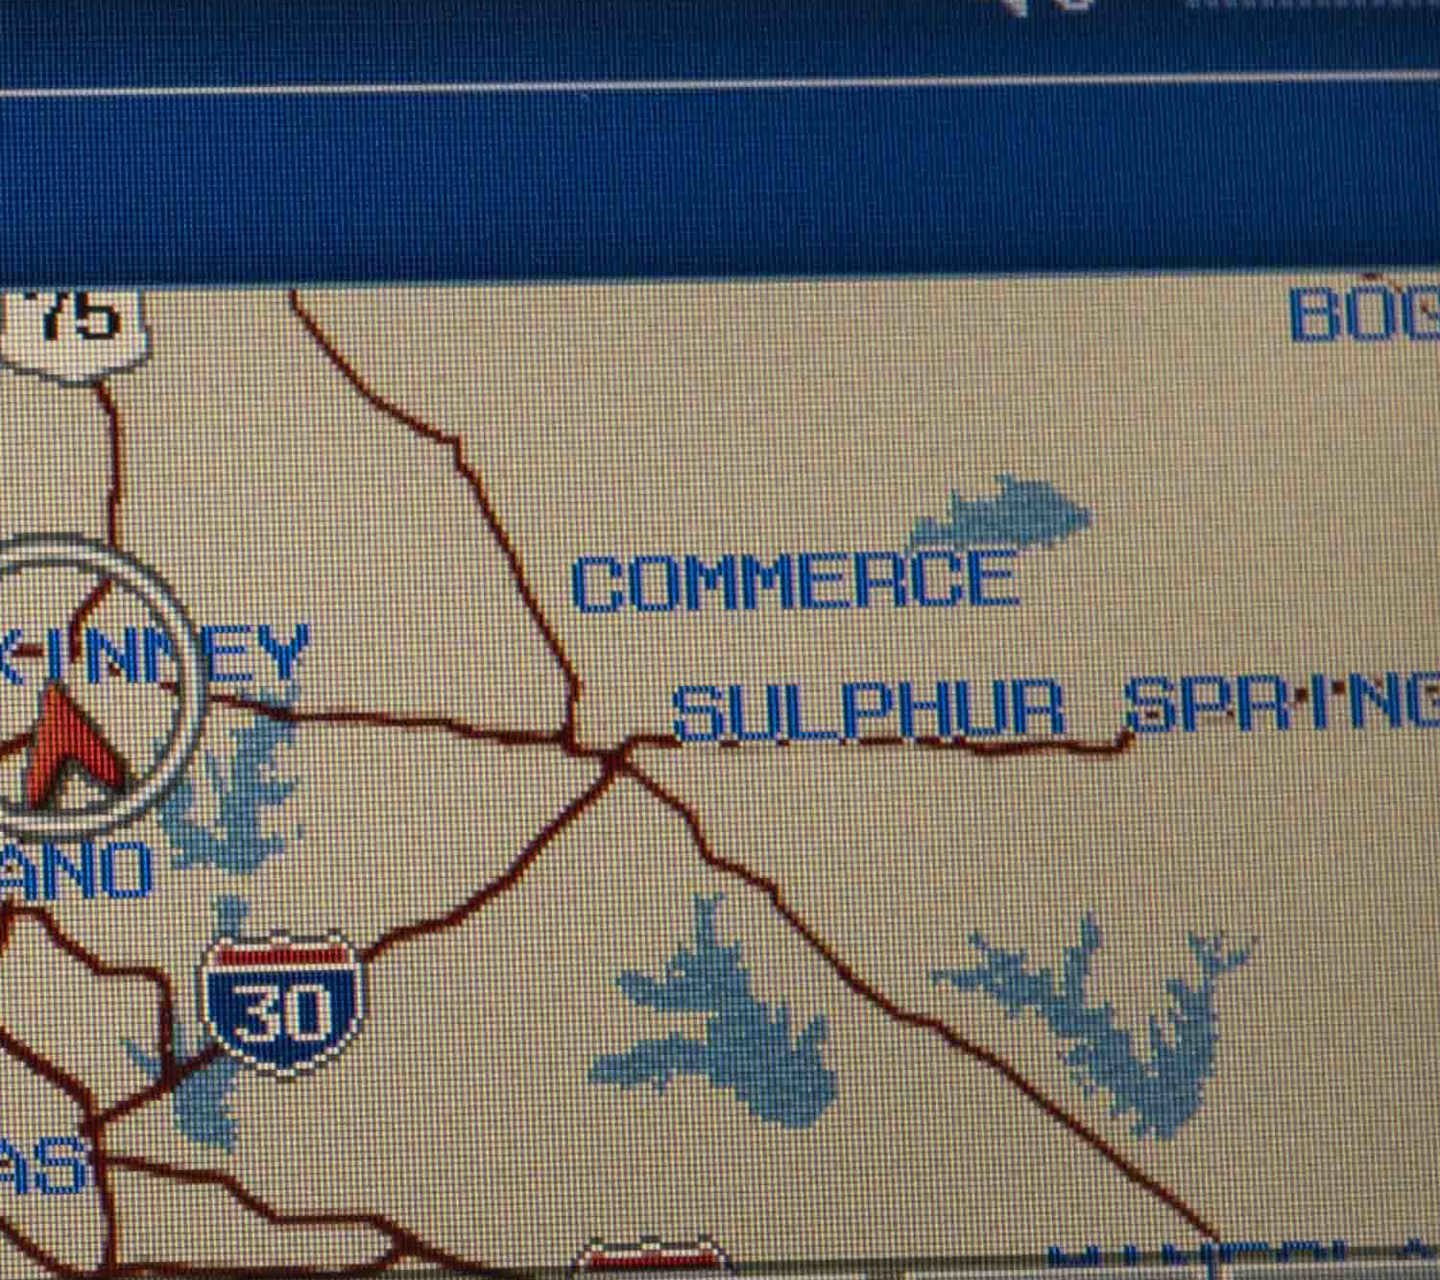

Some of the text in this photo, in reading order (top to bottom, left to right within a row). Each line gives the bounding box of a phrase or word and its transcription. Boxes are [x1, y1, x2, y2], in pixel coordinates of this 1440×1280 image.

[23, 291, 122, 341] 75
[571, 549, 1021, 614] COMMERCE
[672, 678, 1064, 742] SULPHUR
[231, 983, 333, 1044] 30
